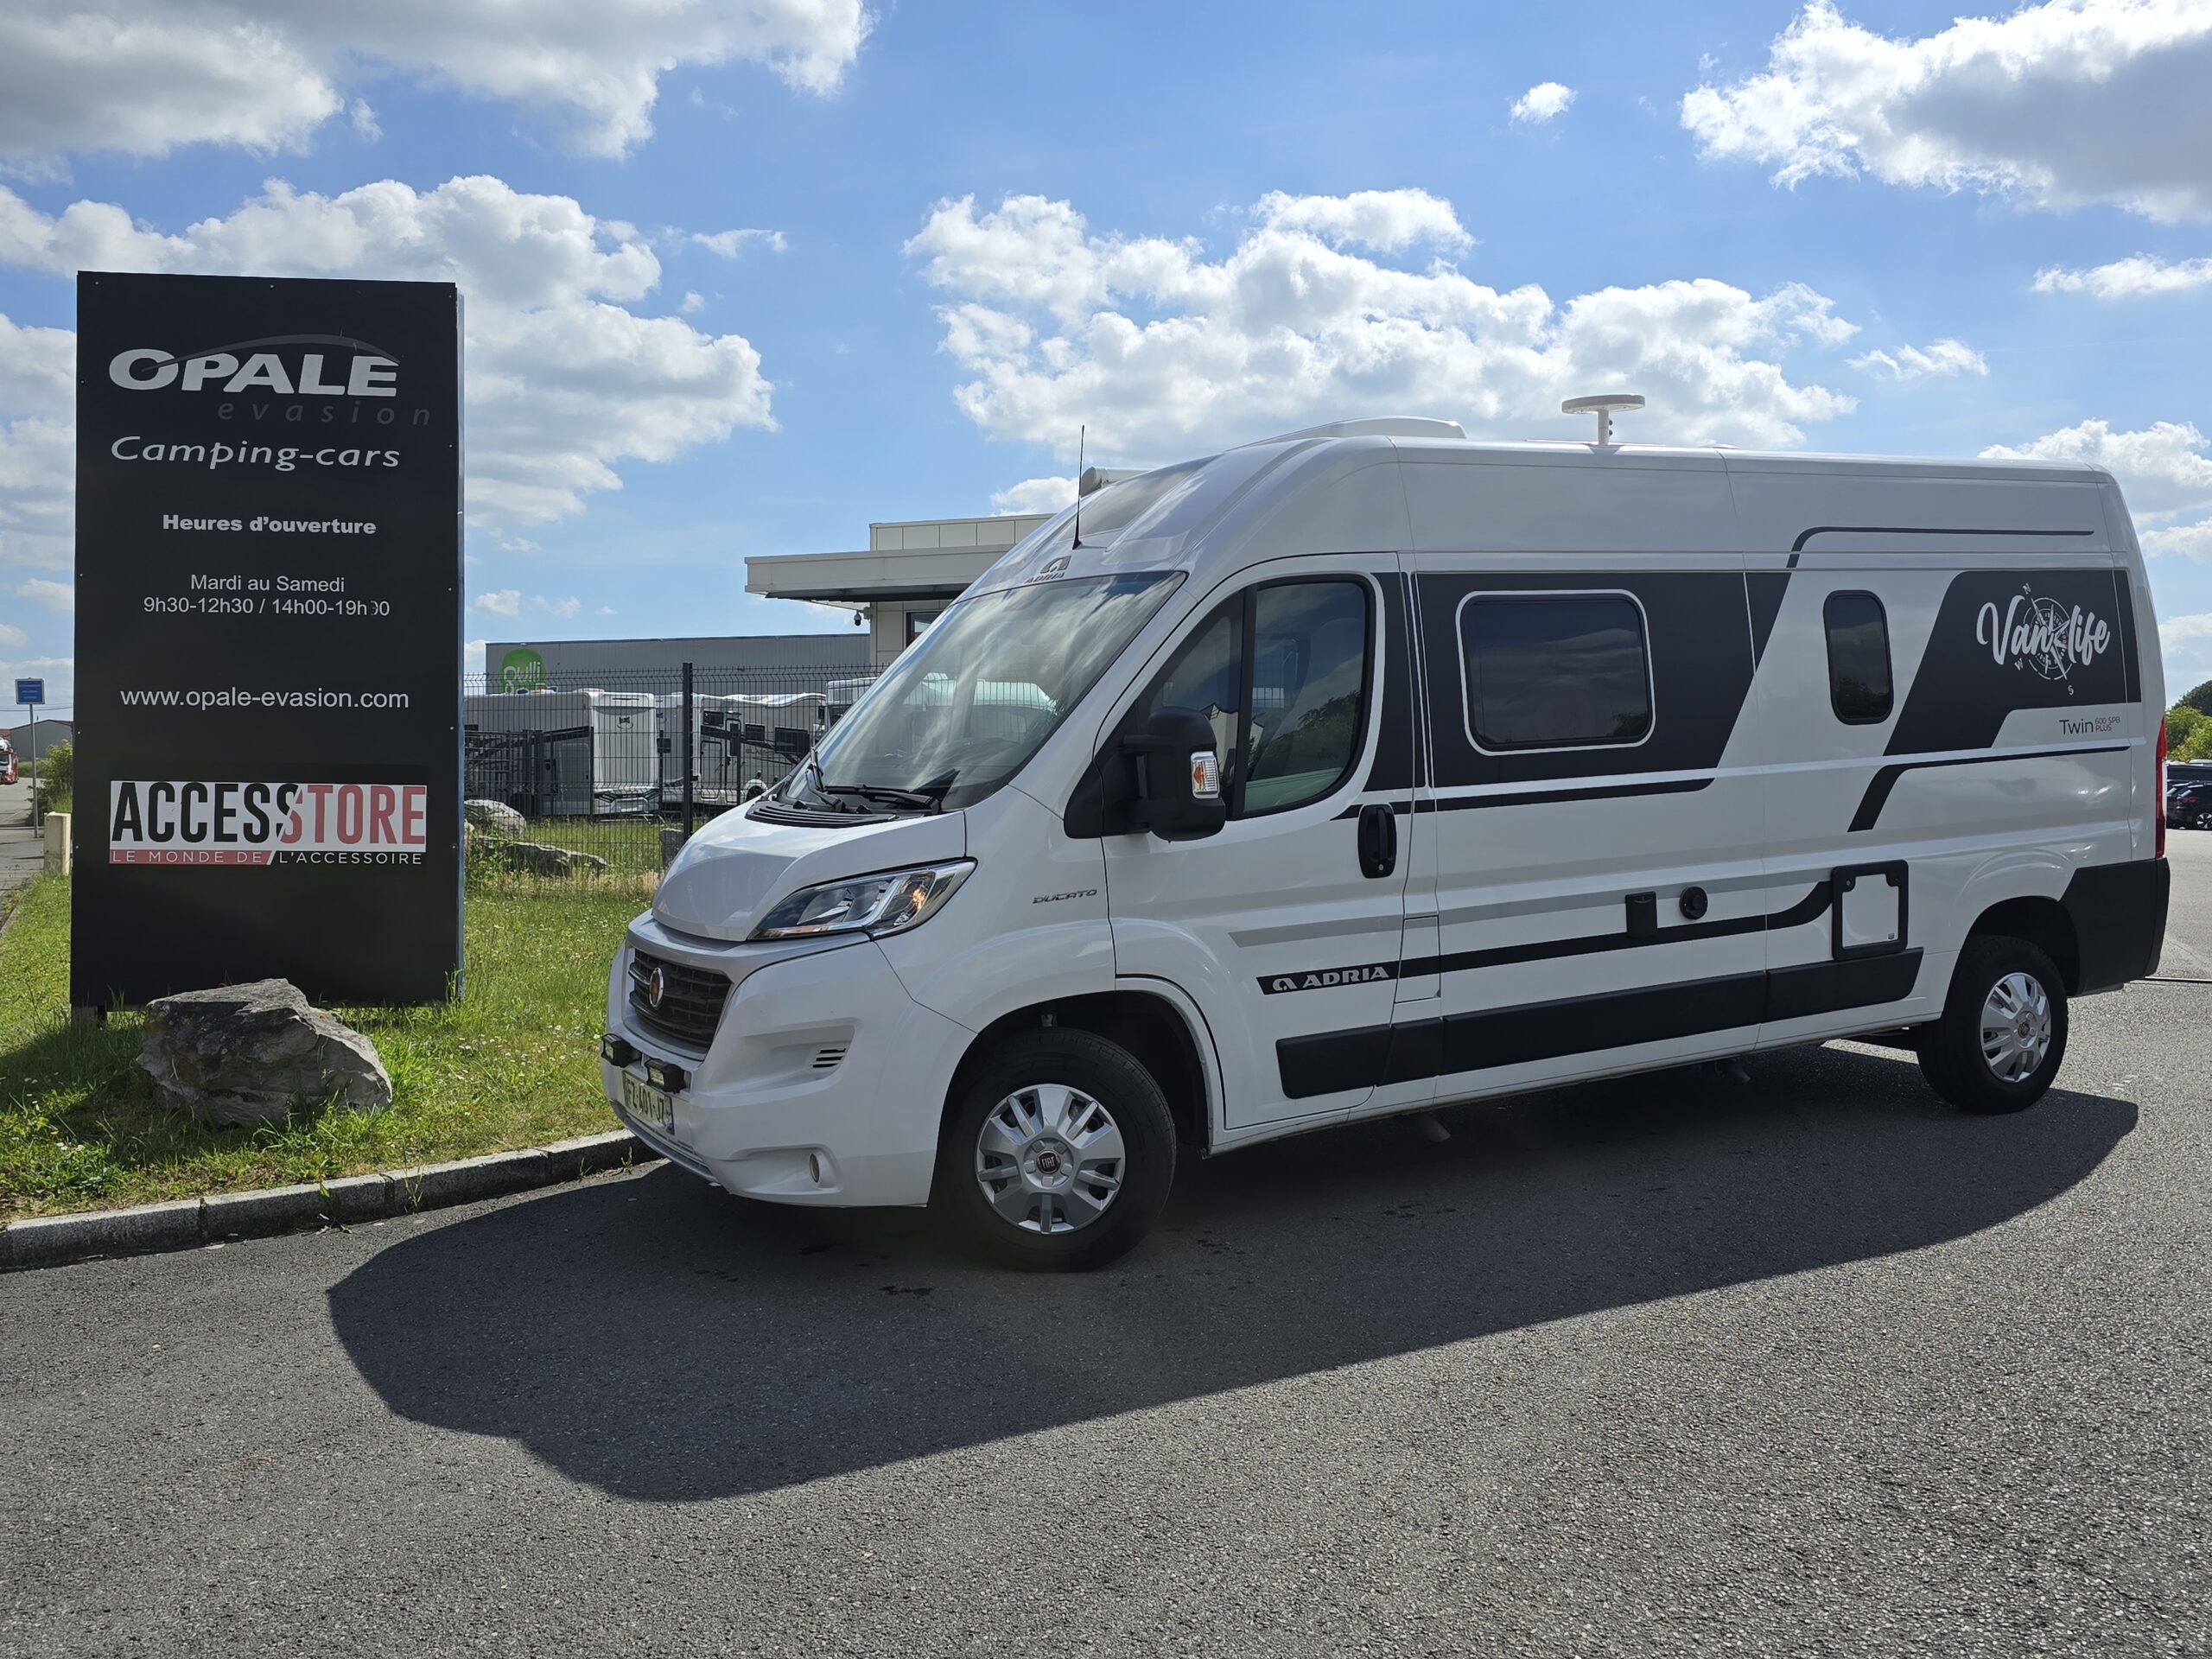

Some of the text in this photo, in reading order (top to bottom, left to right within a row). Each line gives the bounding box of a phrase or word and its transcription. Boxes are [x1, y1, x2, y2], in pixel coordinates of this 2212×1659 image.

[109, 348, 399, 397] OPALE
[218, 401, 429, 424] evasion
[111, 435, 400, 472] Camping-cars
[162, 514, 242, 531] Heures
[190, 575, 345, 592] Mardi au Samedi
[143, 597, 254, 614] 9h30-12h30
[120, 687, 409, 711] www.opale-evasion.com
[2059, 718, 2094, 735] Twin
[112, 850, 136, 862] LE
[149, 850, 224, 863] MONDE
[237, 851, 263, 863] DE
[1033, 889, 1098, 904] DUCATO
[1302, 966, 1389, 989] ADRIA
[1041, 1156, 1055, 1168] FIAT
